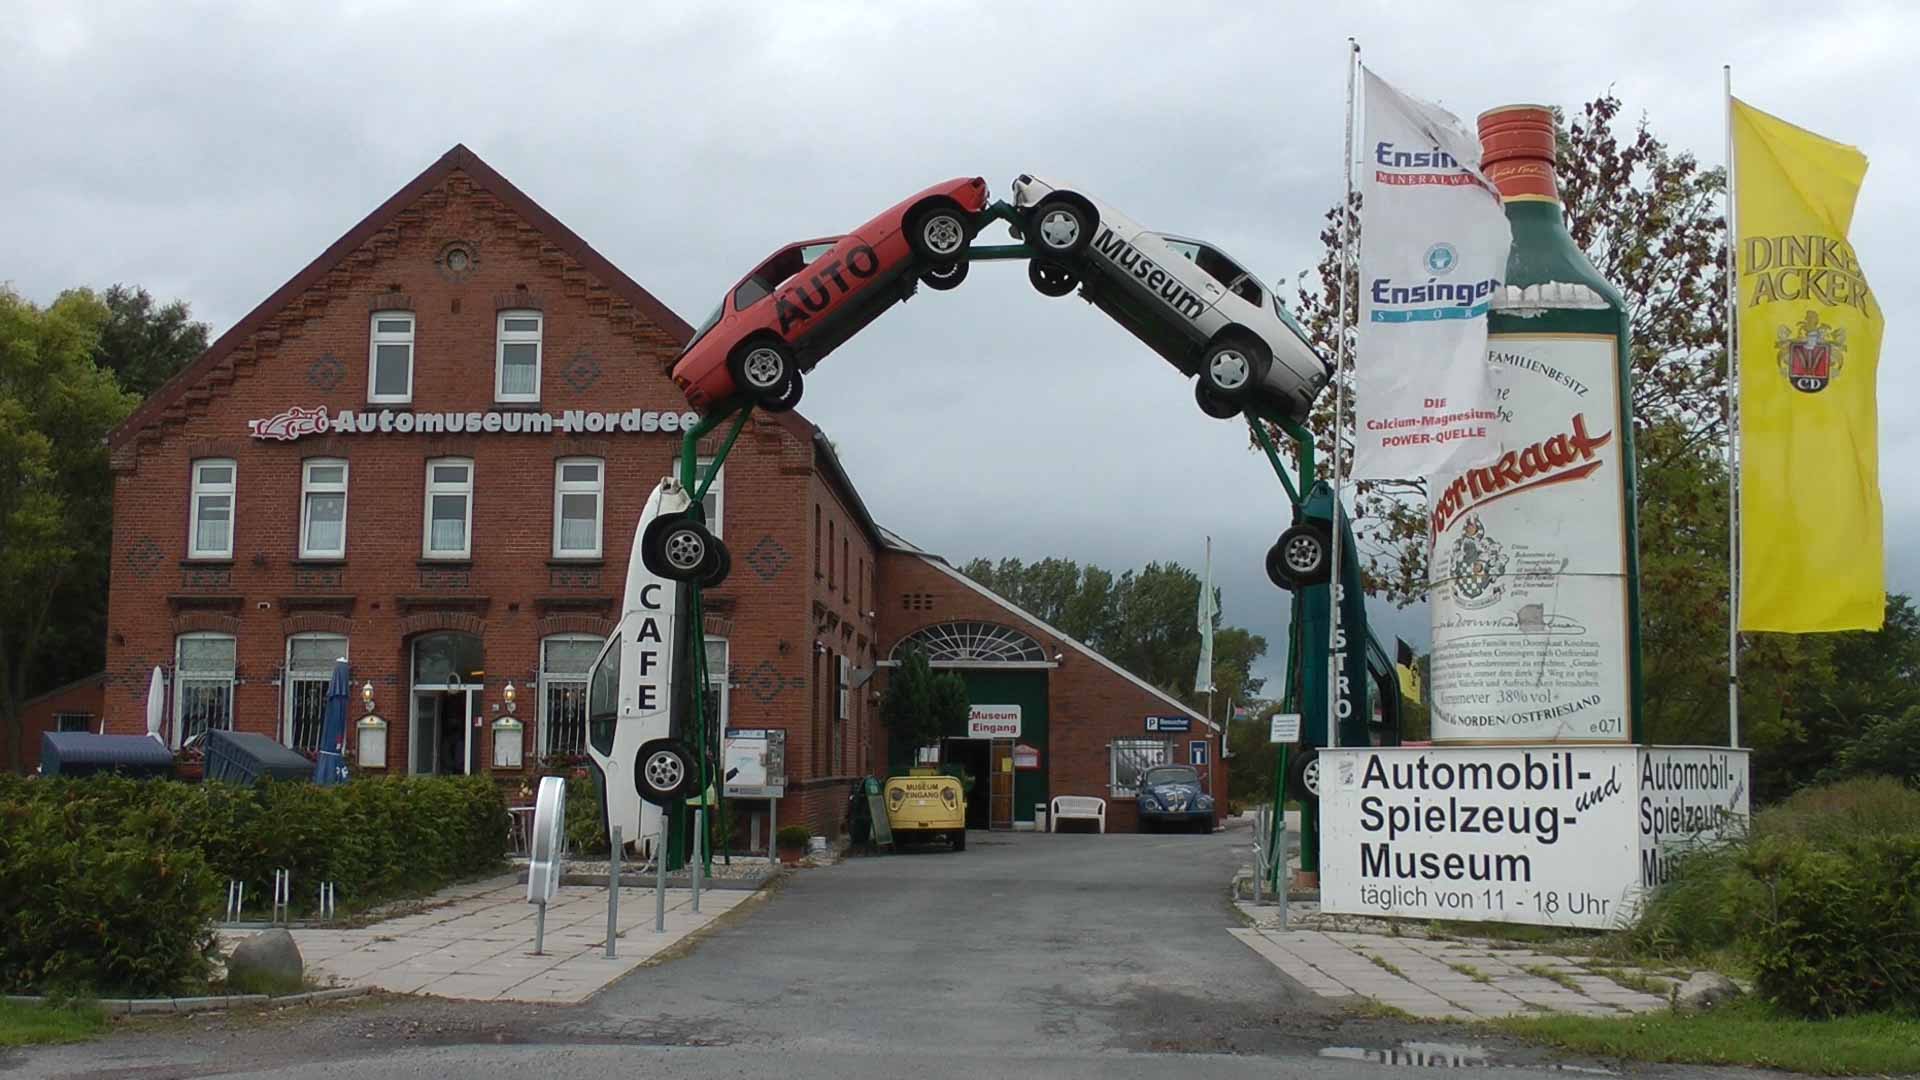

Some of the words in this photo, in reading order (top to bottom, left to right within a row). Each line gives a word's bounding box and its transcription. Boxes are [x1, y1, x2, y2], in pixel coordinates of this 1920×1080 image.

[1375, 142, 1460, 168] Ensin
[1378, 172, 1471, 186] MINERALWA
[773, 243, 880, 335] AUTO
[1094, 228, 1207, 321] Museum
[1370, 278, 1502, 307] Ensinger
[1748, 267, 1870, 318] ACKER
[1377, 310, 1474, 322] SPOR
[1487, 350, 1589, 397] FAMILIENBESITZ
[1797, 378, 1821, 389] CD
[1423, 398, 1448, 409] DIE
[334, 408, 700, 433] Automuseum-Nordsee
[1382, 427, 1487, 448] POWER-QUELLE
[636, 583, 662, 710] CAFE
[1333, 583, 1352, 719] BISTRO
[1496, 690, 1528, 704] 38%
[1529, 689, 1552, 704] vol
[972, 711, 1018, 720] Museum
[972, 723, 1017, 733] Eingang
[1360, 752, 1591, 790] Automobil-
[1641, 752, 1734, 791] Automobil-
[1574, 766, 1622, 812] und
[1359, 796, 1577, 844] Spielzeug-
[1360, 843, 1531, 882] Museum
[1360, 884, 1427, 911] täglich
[1438, 892, 1473, 909] von
[1482, 890, 1504, 910] 11
[1533, 891, 1560, 913] 18
[1568, 892, 1610, 916] Uhr
